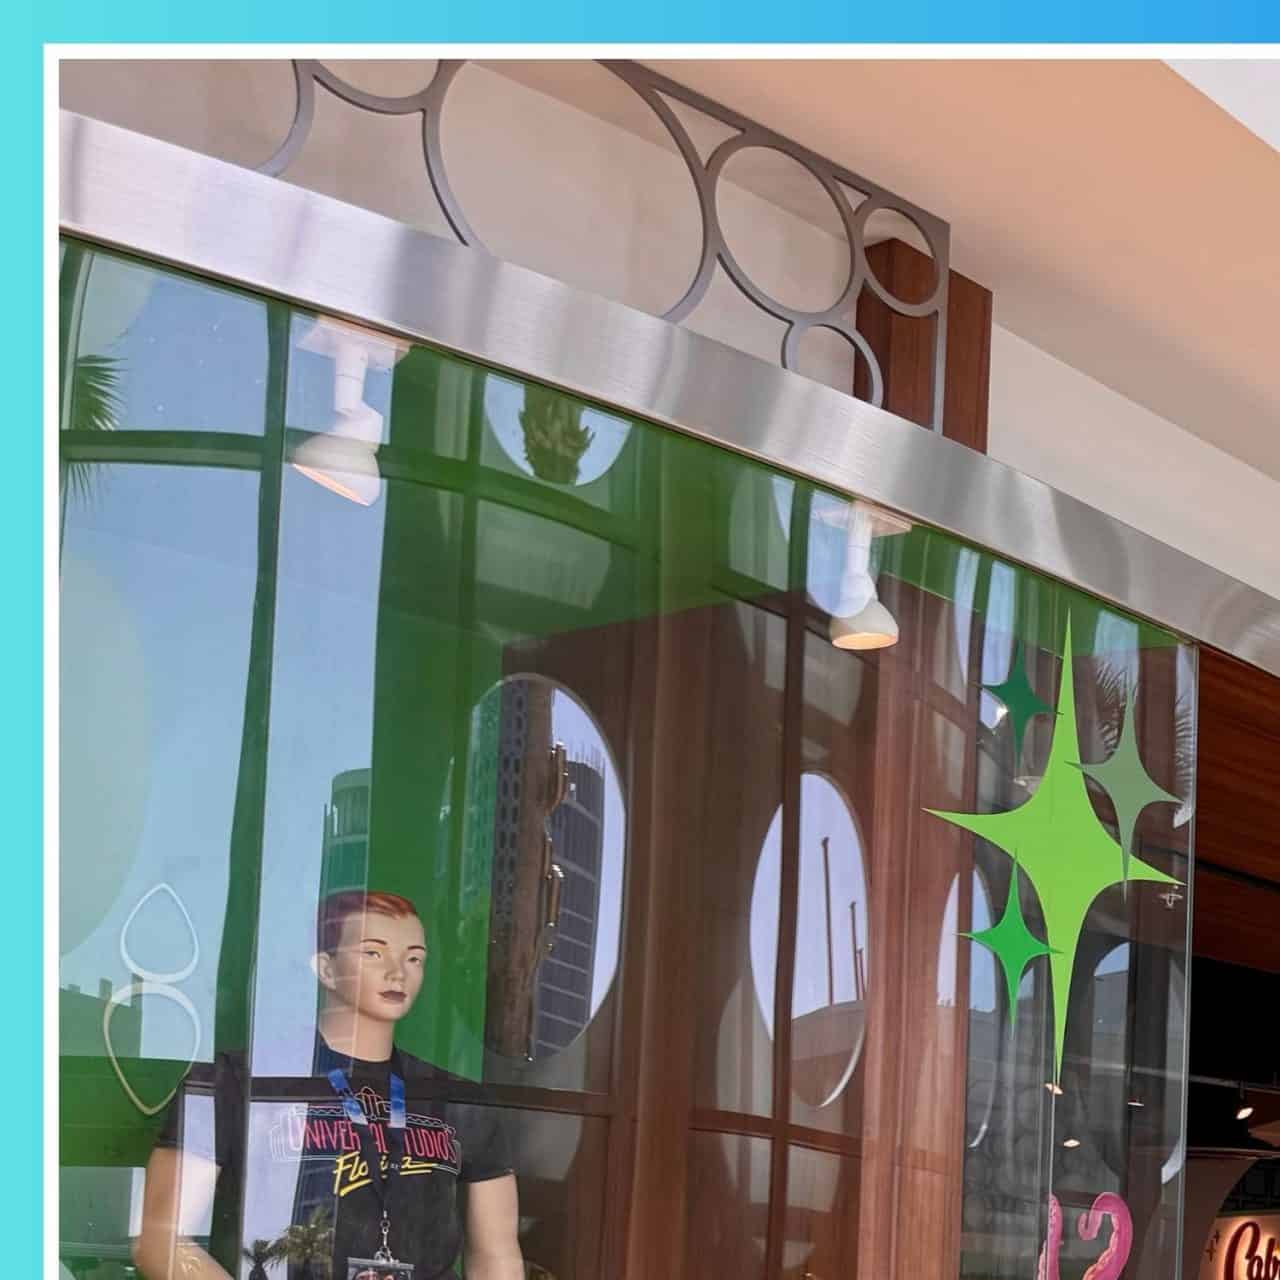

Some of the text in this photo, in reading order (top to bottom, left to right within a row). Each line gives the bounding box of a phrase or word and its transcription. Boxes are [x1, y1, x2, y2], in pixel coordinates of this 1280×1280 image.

[287, 1112, 457, 1165] UNIVERAL TUDIOS
[333, 1151, 433, 1196] Floia
